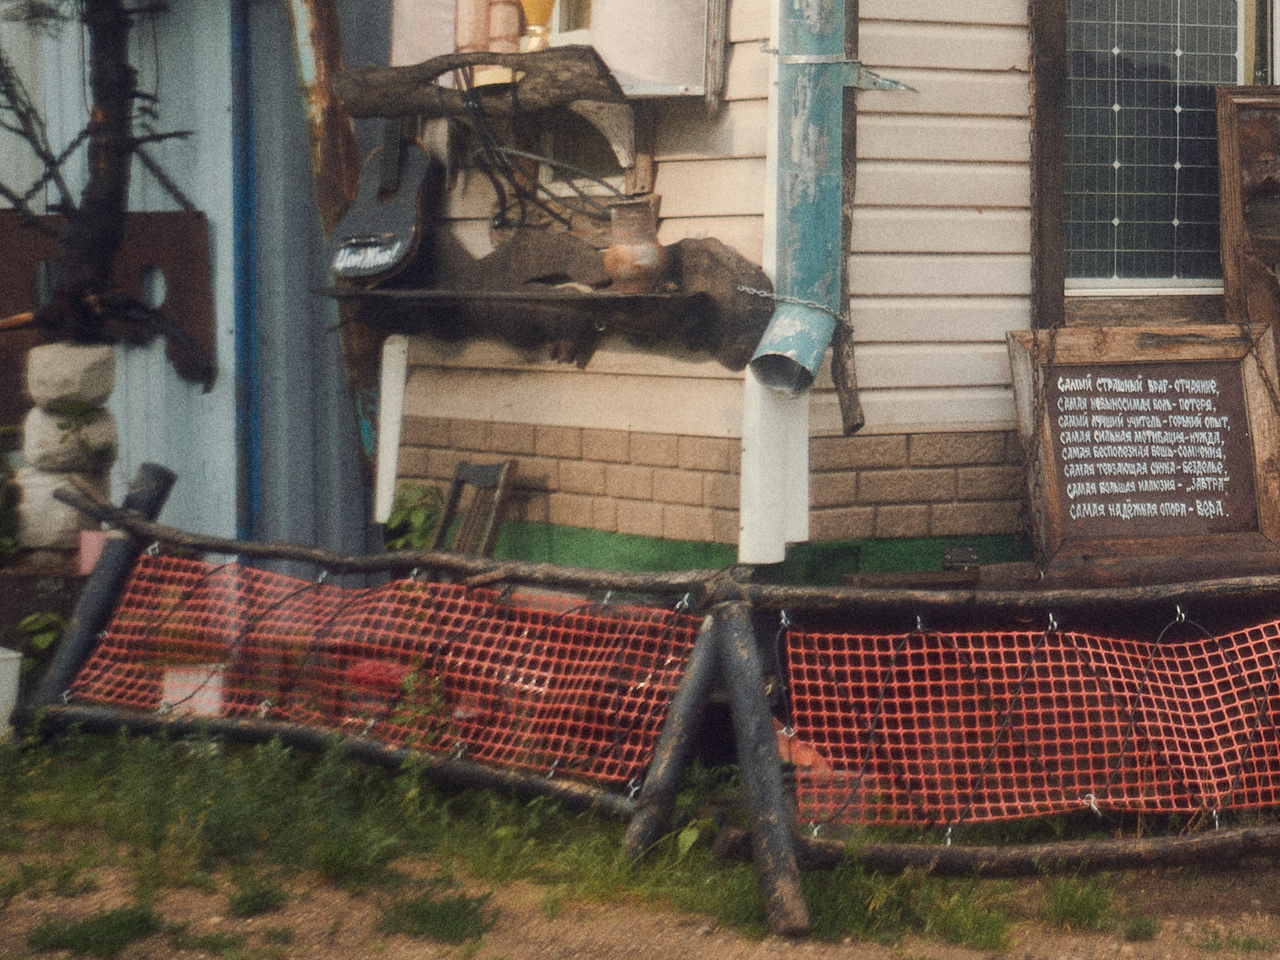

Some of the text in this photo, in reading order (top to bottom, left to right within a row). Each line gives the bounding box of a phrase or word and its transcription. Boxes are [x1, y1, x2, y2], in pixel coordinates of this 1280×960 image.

[1057, 373, 1093, 392] САМЫЙ
[1096, 374, 1143, 392] СТРАШНЫЙ
[1057, 397, 1087, 412] САМАЯ
[1057, 412, 1089, 428] САМЫЙ
[1060, 430, 1091, 444] САМАЯ
[1062, 446, 1091, 460] САМАЯ
[1064, 463, 1095, 477] САМАЯ
[1066, 482, 1097, 499] САМАЯ
[1070, 503, 1105, 520] САМАЯ
